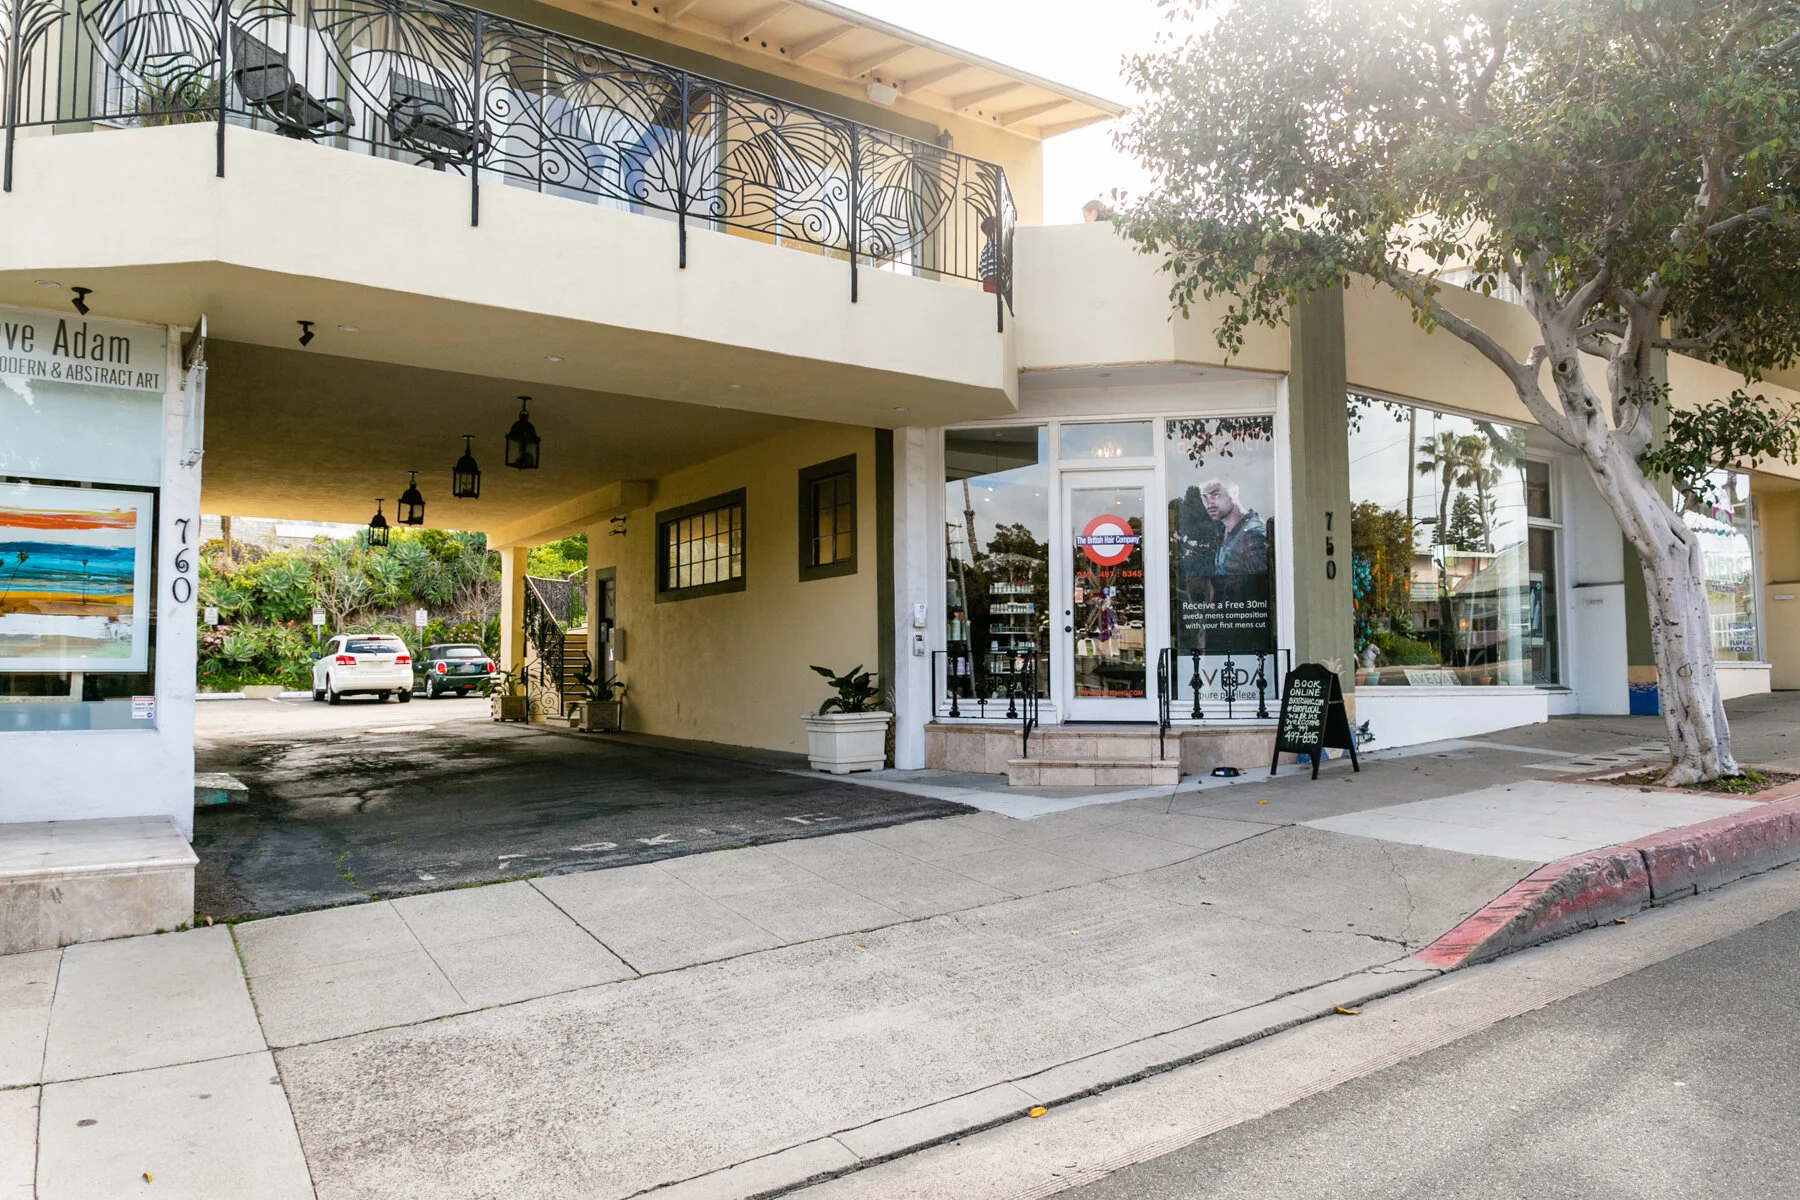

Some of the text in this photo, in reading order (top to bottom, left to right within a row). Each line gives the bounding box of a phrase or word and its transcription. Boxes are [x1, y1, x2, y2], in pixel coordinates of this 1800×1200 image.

[0, 319, 130, 365] ve Adam
[51, 361, 62, 379] &
[65, 364, 132, 387] ABSTRACT
[136, 372, 160, 389] ART
[1076, 535, 1140, 545] The British Hair Company
[1324, 511, 1337, 580] 750
[172, 518, 192, 604] 760
[1099, 570, 1114, 578] 497
[1121, 570, 1143, 578] 8345
[1182, 601, 1215, 610] Receive
[1225, 600, 1245, 609] Free
[1246, 599, 1268, 609] 30ml
[1182, 612, 1203, 620] aveda
[1225, 611, 1268, 620] composition
[1185, 621, 1201, 629] with
[1219, 621, 1233, 629] first
[1188, 668, 1265, 686] VDA
[1294, 679, 1322, 689] BOOK
[1200, 690, 1257, 700] pure pilege
[1290, 688, 1321, 697] ONLINE
